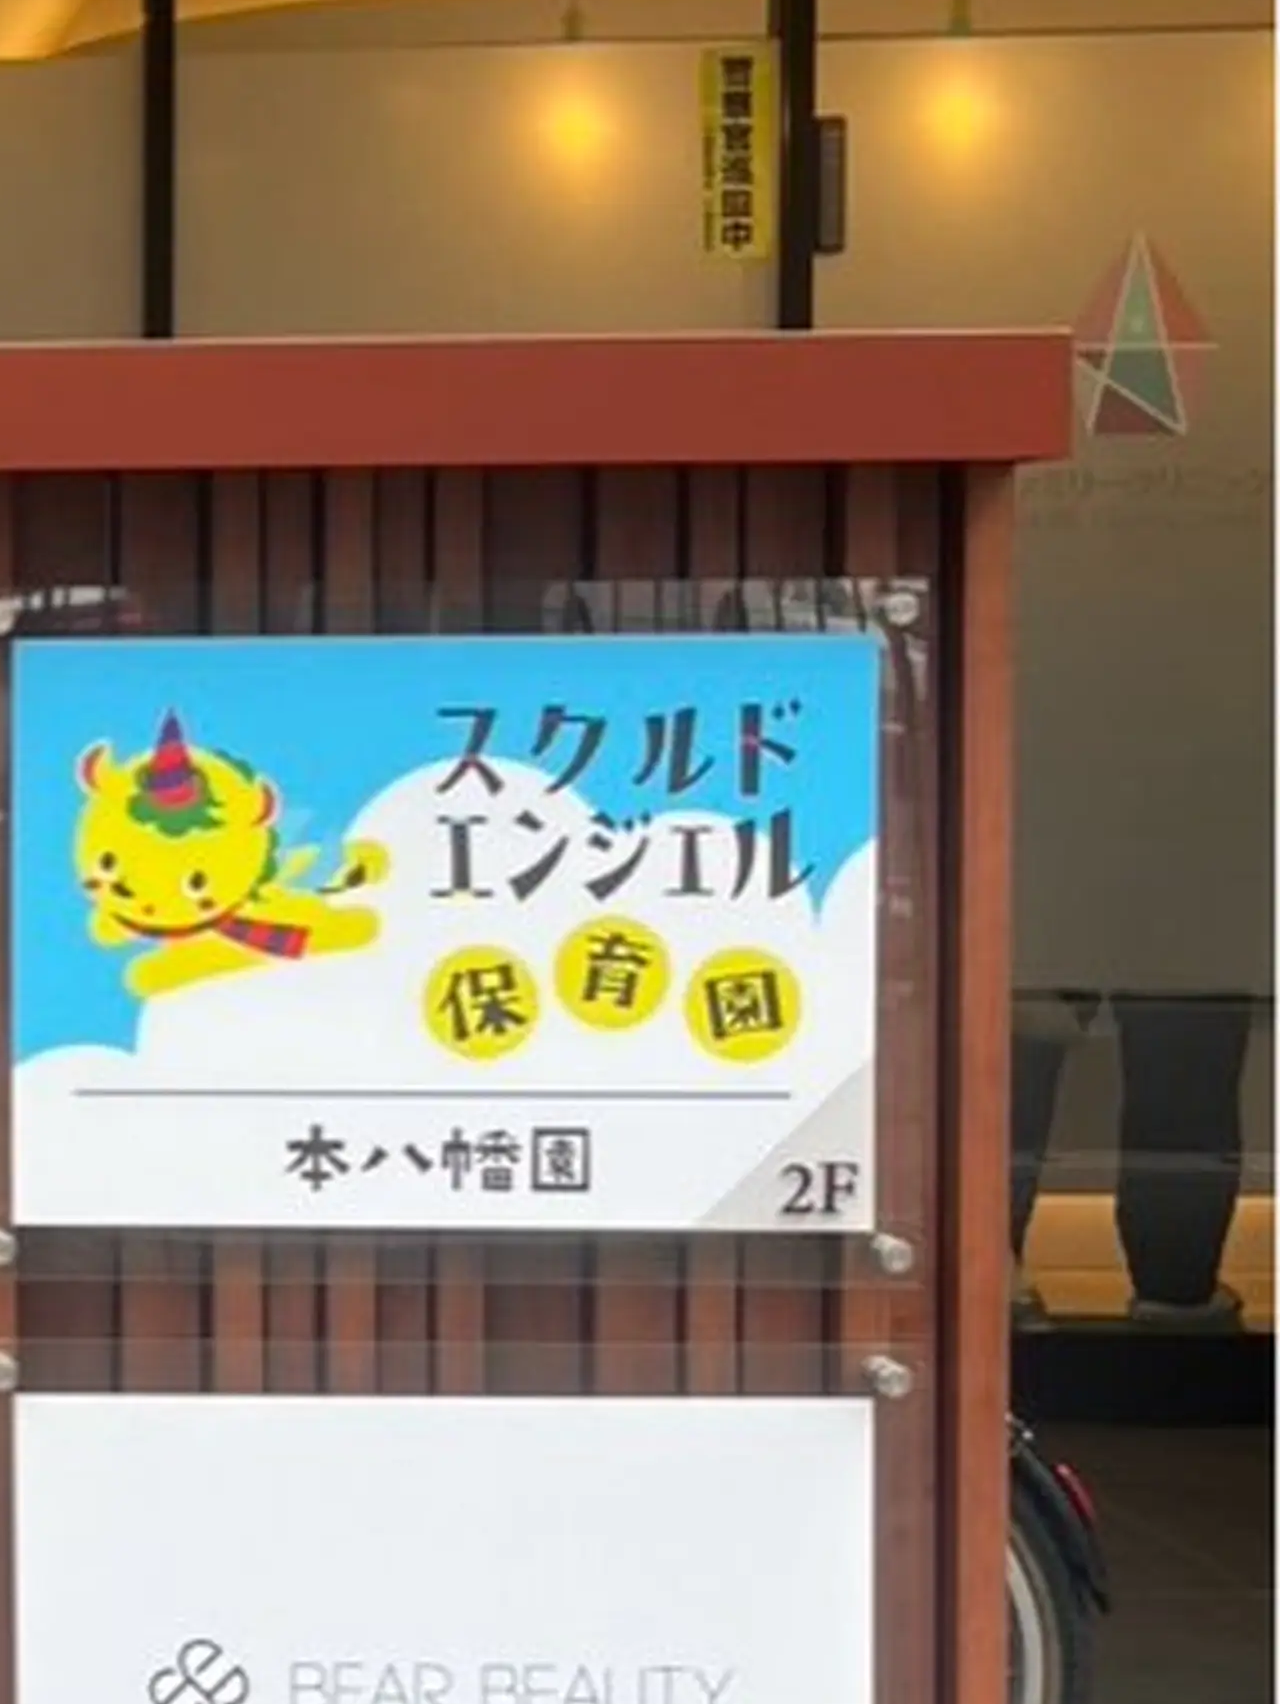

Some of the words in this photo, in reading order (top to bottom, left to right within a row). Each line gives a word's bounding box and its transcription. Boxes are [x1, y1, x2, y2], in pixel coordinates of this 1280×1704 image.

[435, 698, 803, 797] スクルド
[429, 807, 816, 902] エンジェル
[439, 931, 785, 1041] 保育園
[287, 1125, 591, 1194] 本八幡園
[779, 1162, 859, 1218] 2F
